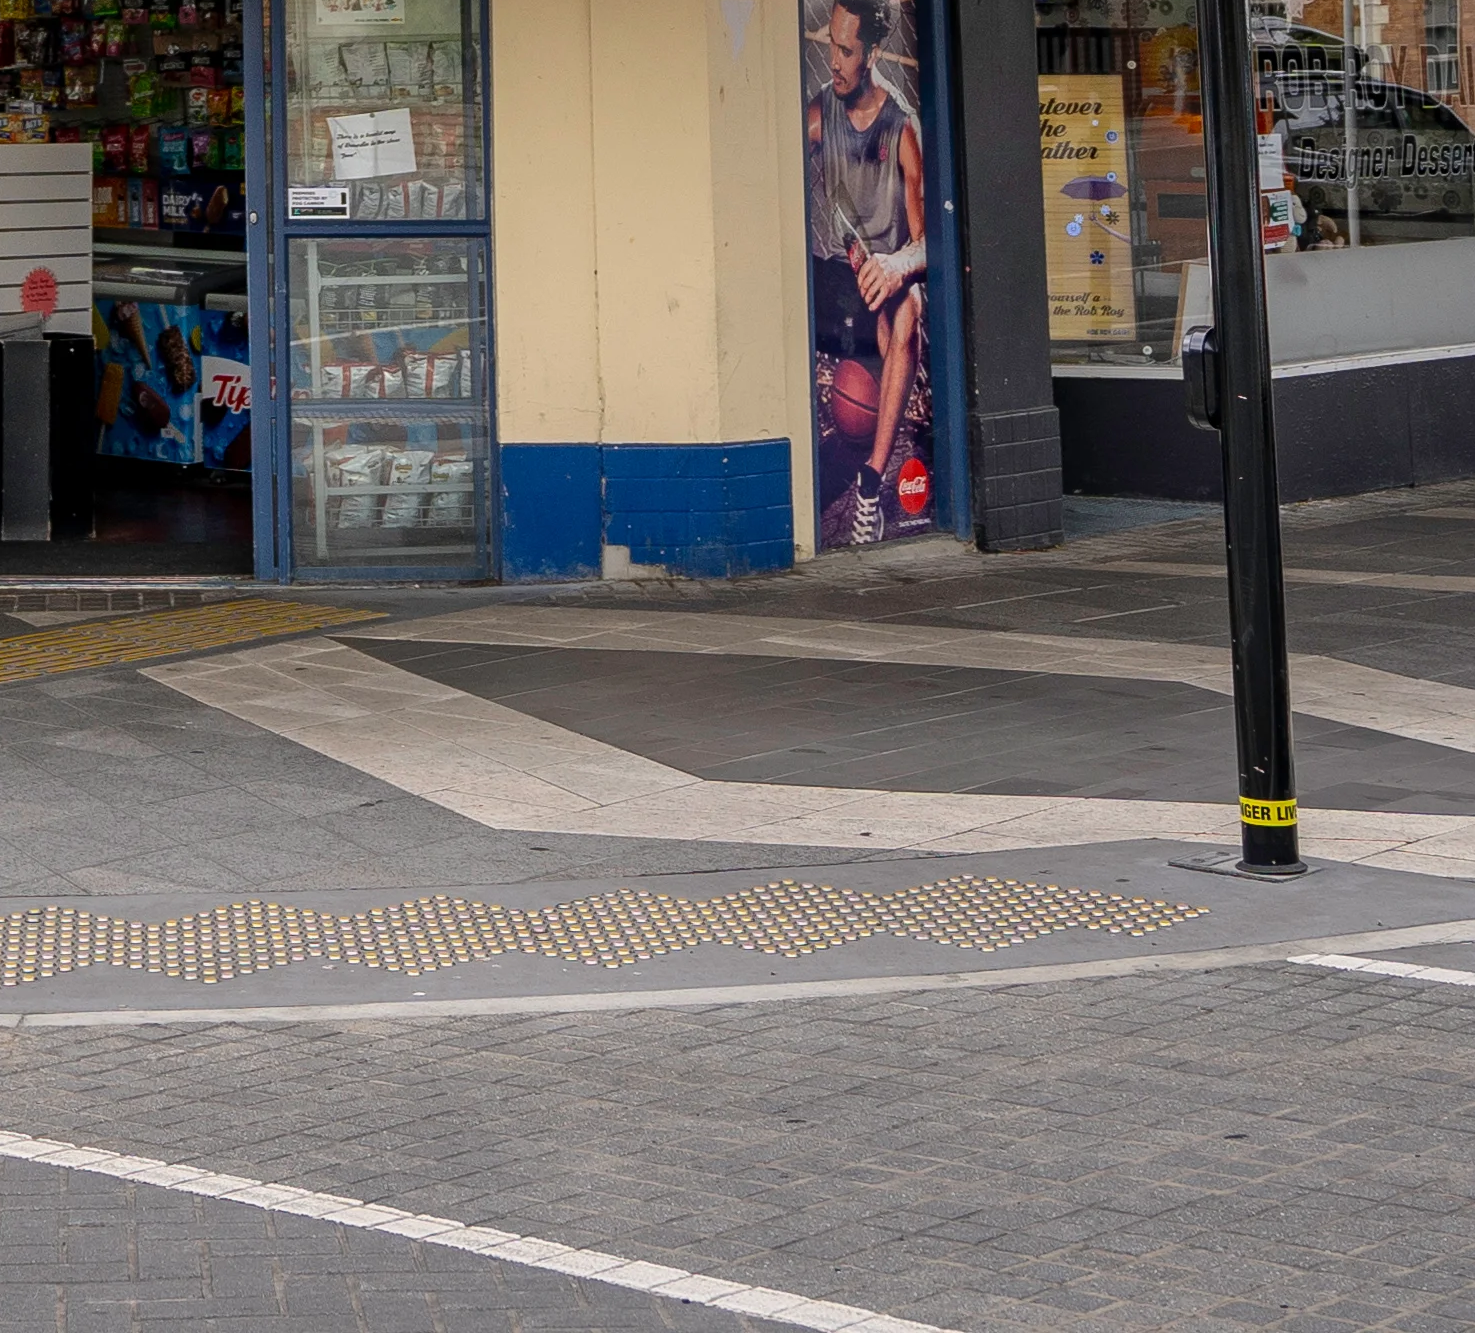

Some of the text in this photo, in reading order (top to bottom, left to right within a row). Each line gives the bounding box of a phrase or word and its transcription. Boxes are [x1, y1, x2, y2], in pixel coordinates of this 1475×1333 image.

[1256, 44, 1329, 112] ROB
[1344, 44, 1407, 110] ROY
[1040, 119, 1067, 137] he
[1298, 136, 1397, 190] Designer
[162, 193, 191, 207] DAIRY
[163, 205, 187, 217] MILK
[1053, 305, 1125, 318] the Rob Roy
[212, 374, 251, 413] Tip
